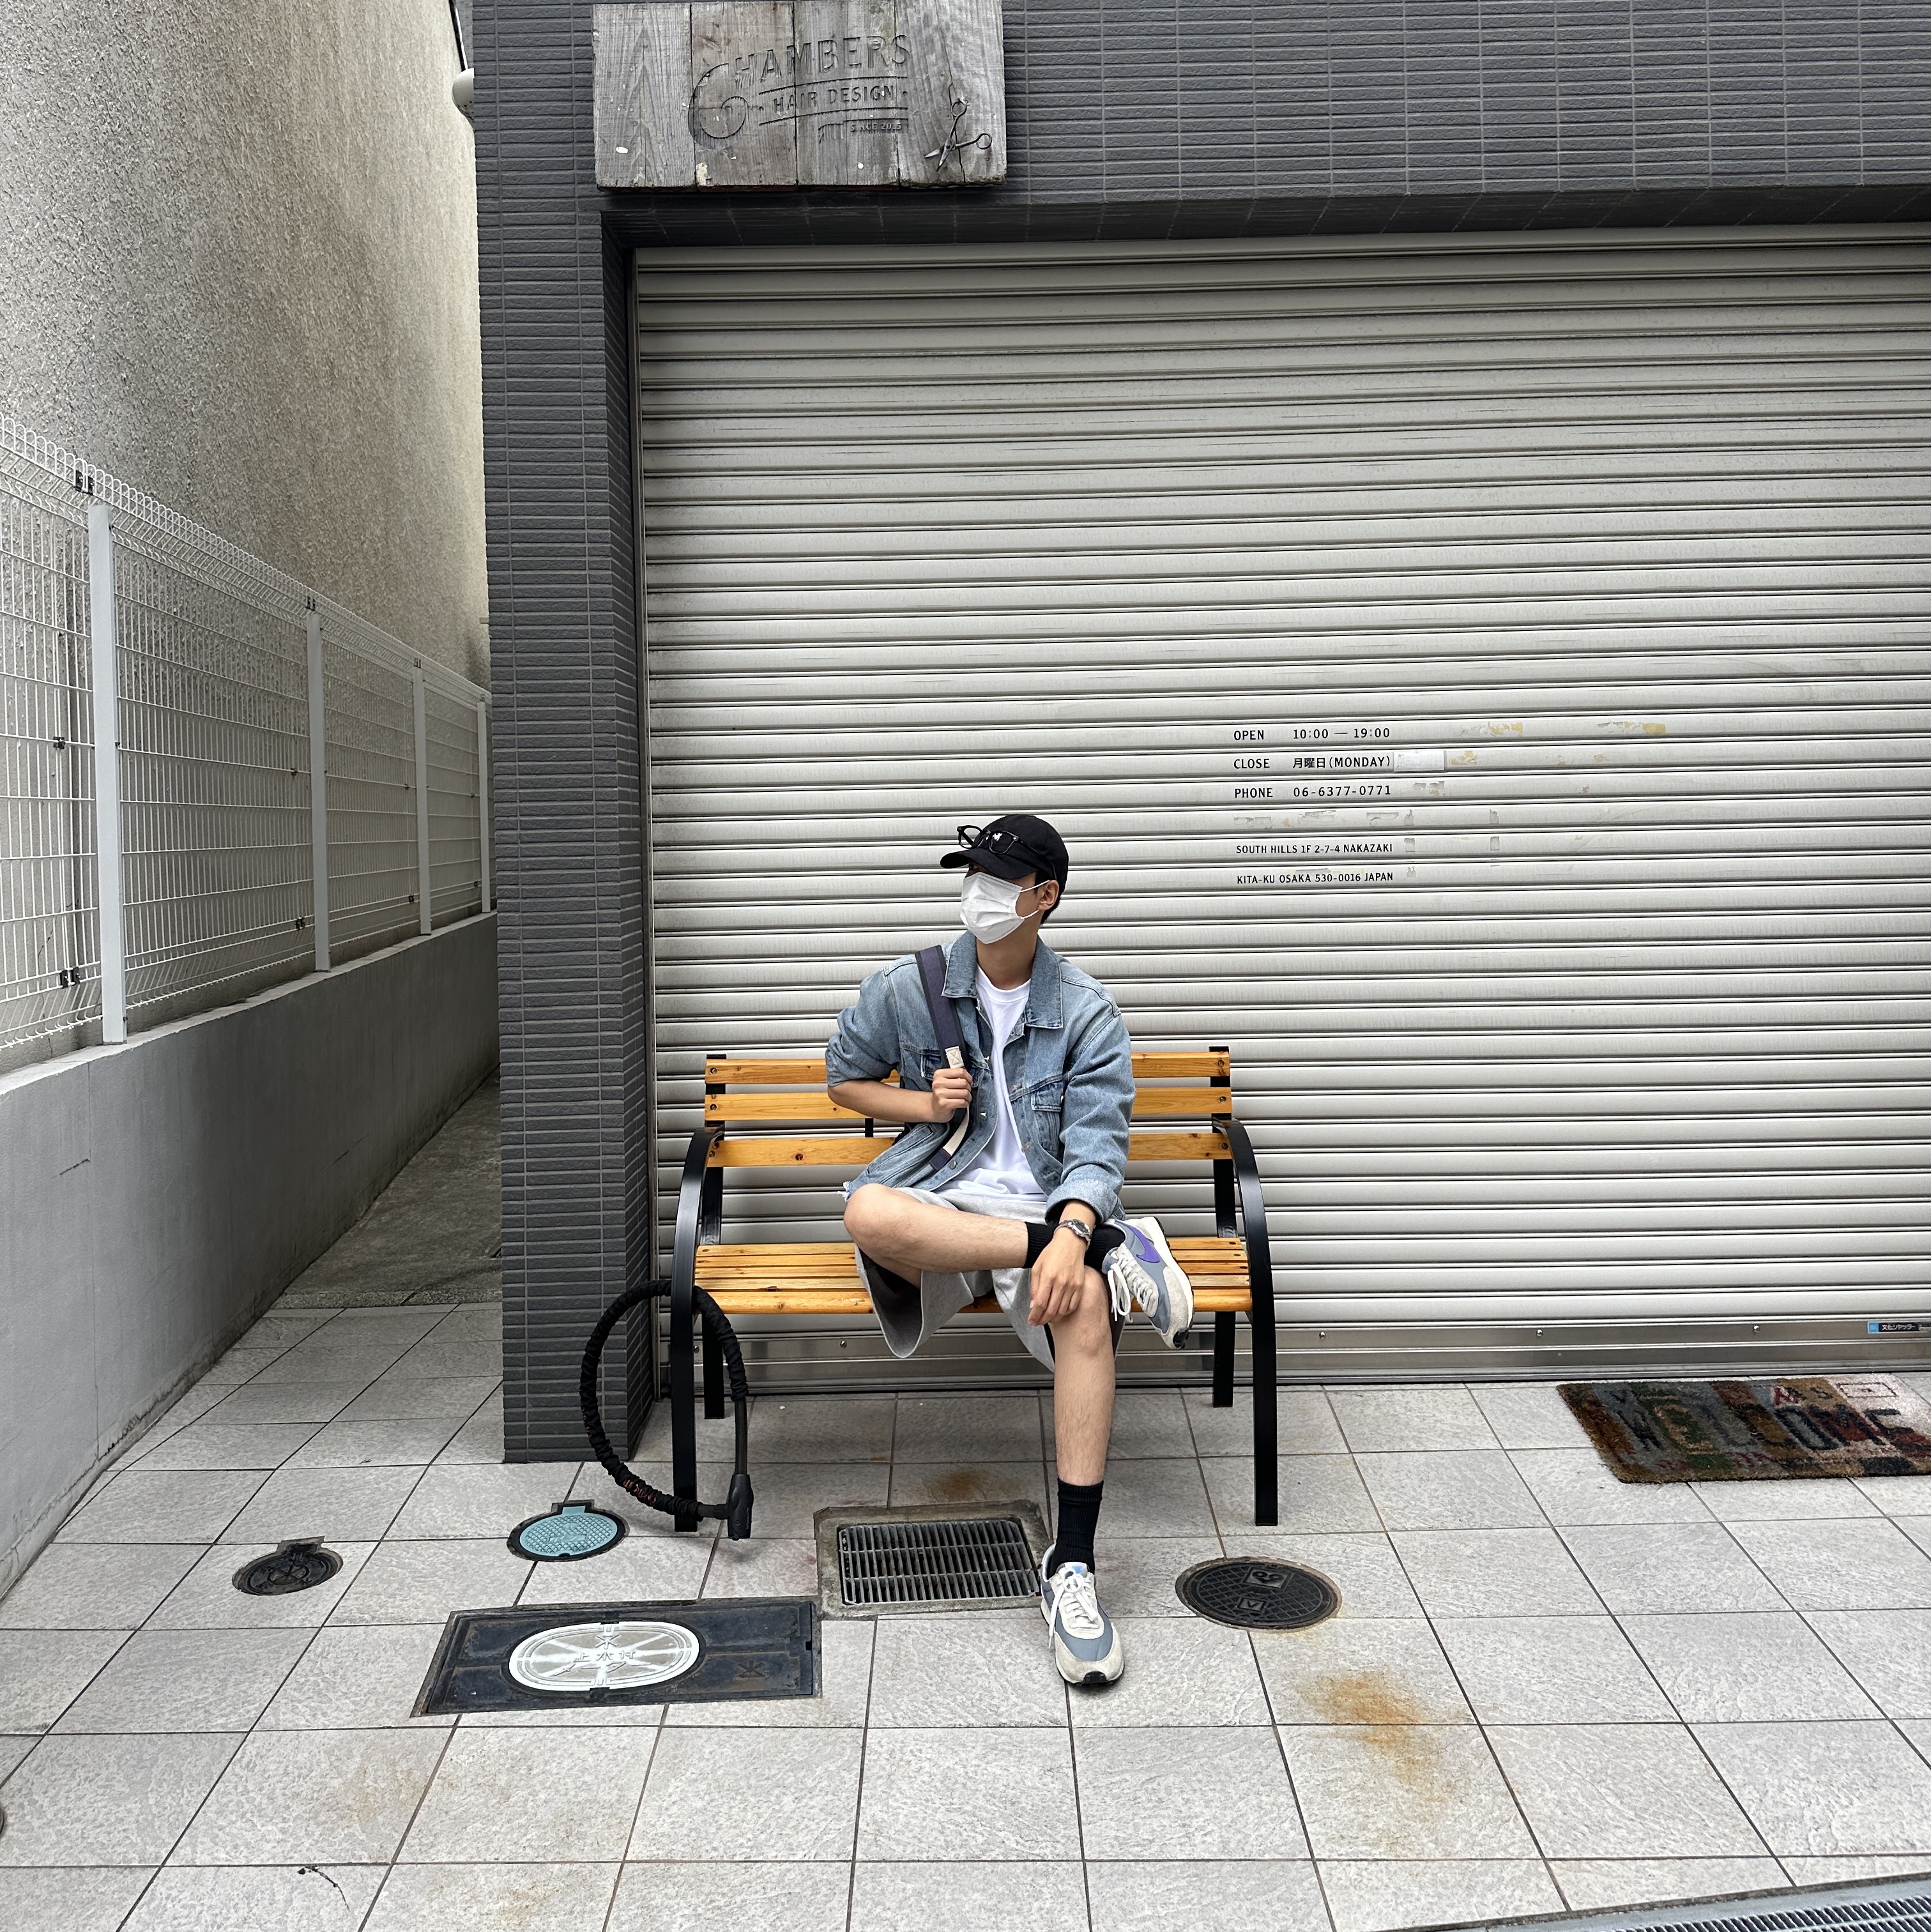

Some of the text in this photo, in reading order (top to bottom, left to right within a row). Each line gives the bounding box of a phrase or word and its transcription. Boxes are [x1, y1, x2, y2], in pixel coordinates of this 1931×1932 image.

[773, 84, 894, 114] HAIR DESIGN
[850, 123, 877, 132] SINCE
[1233, 730, 1264, 740] OPEN
[1293, 729, 1329, 739] 10:00
[1354, 727, 1390, 738] 19:00
[1233, 758, 1271, 769] CLOSE
[1235, 785, 1391, 798] PHONE 06-6377-0771
[1236, 843, 1393, 854] SOUTH HILLS 1F 2-7-4 NAKAZAKI
[1237, 872, 1393, 884] KITA-KU OSAKA 530-0016 JAPAN
